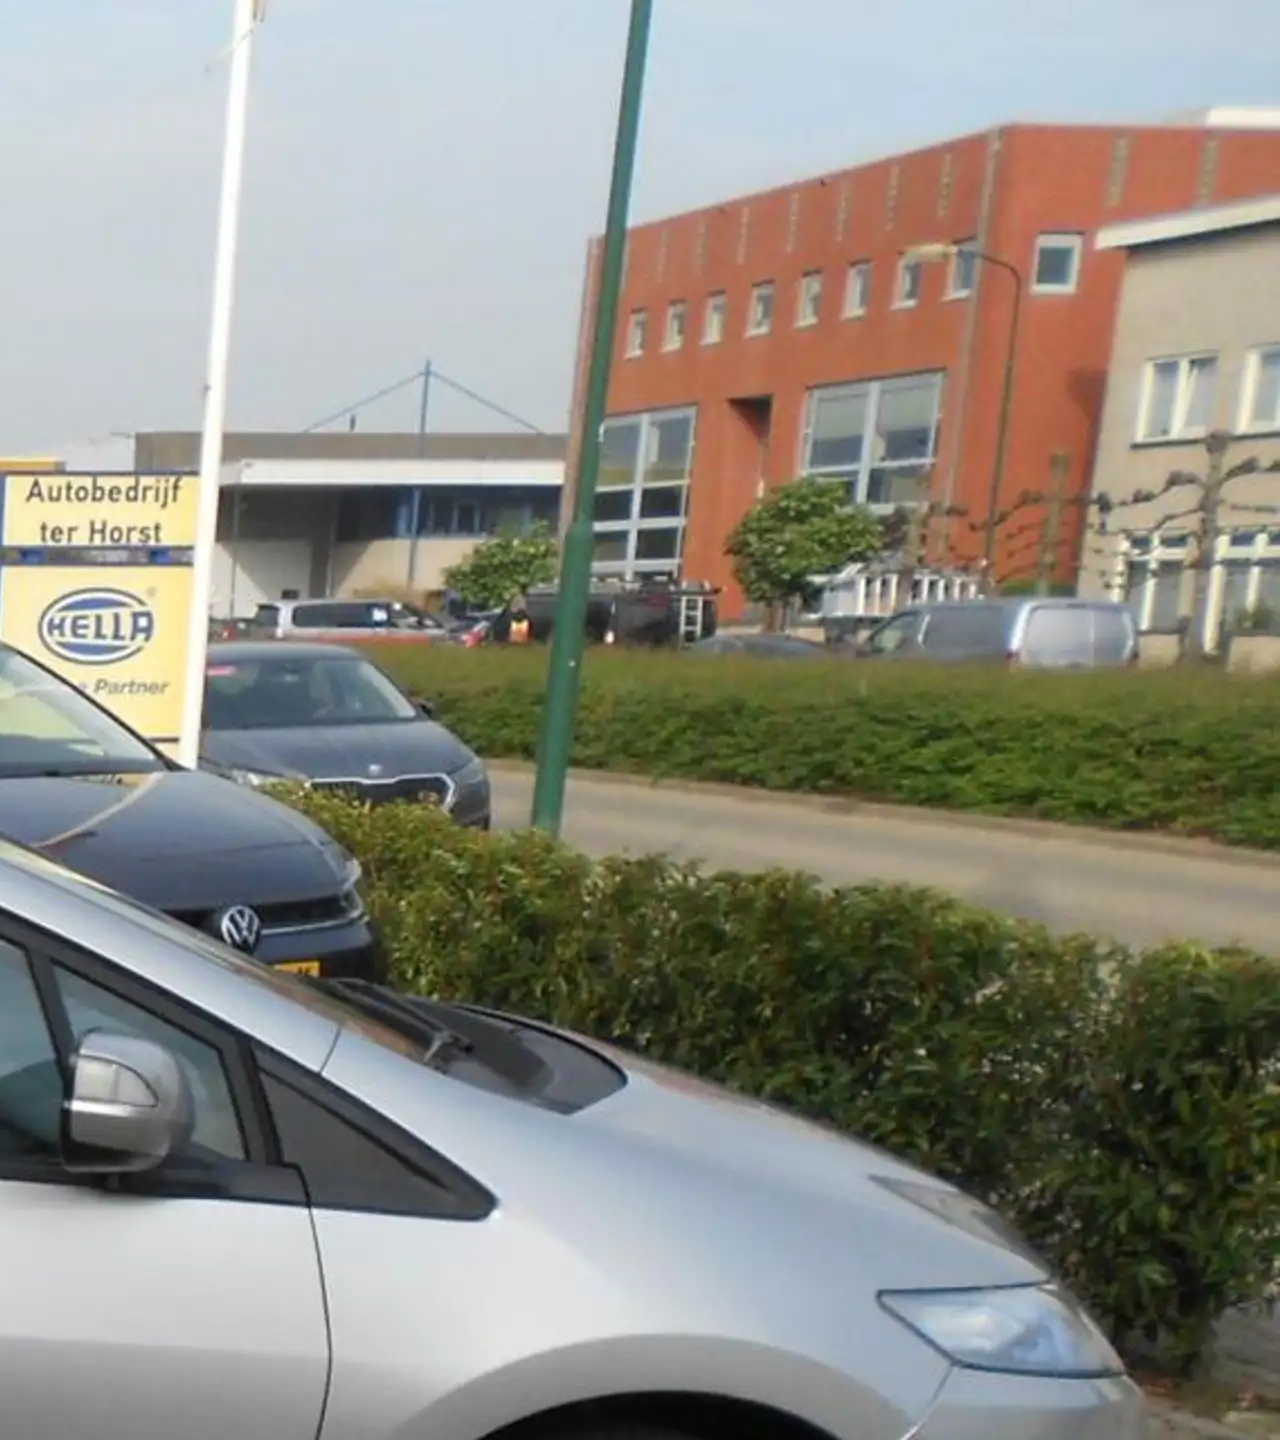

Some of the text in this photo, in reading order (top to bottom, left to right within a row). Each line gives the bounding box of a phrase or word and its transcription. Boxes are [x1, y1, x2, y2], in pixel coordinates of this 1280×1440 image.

[26, 476, 184, 508] Autobedrijf
[40, 519, 162, 543] ter Horst
[46, 610, 154, 643] HELLA
[93, 678, 172, 695] Partner
